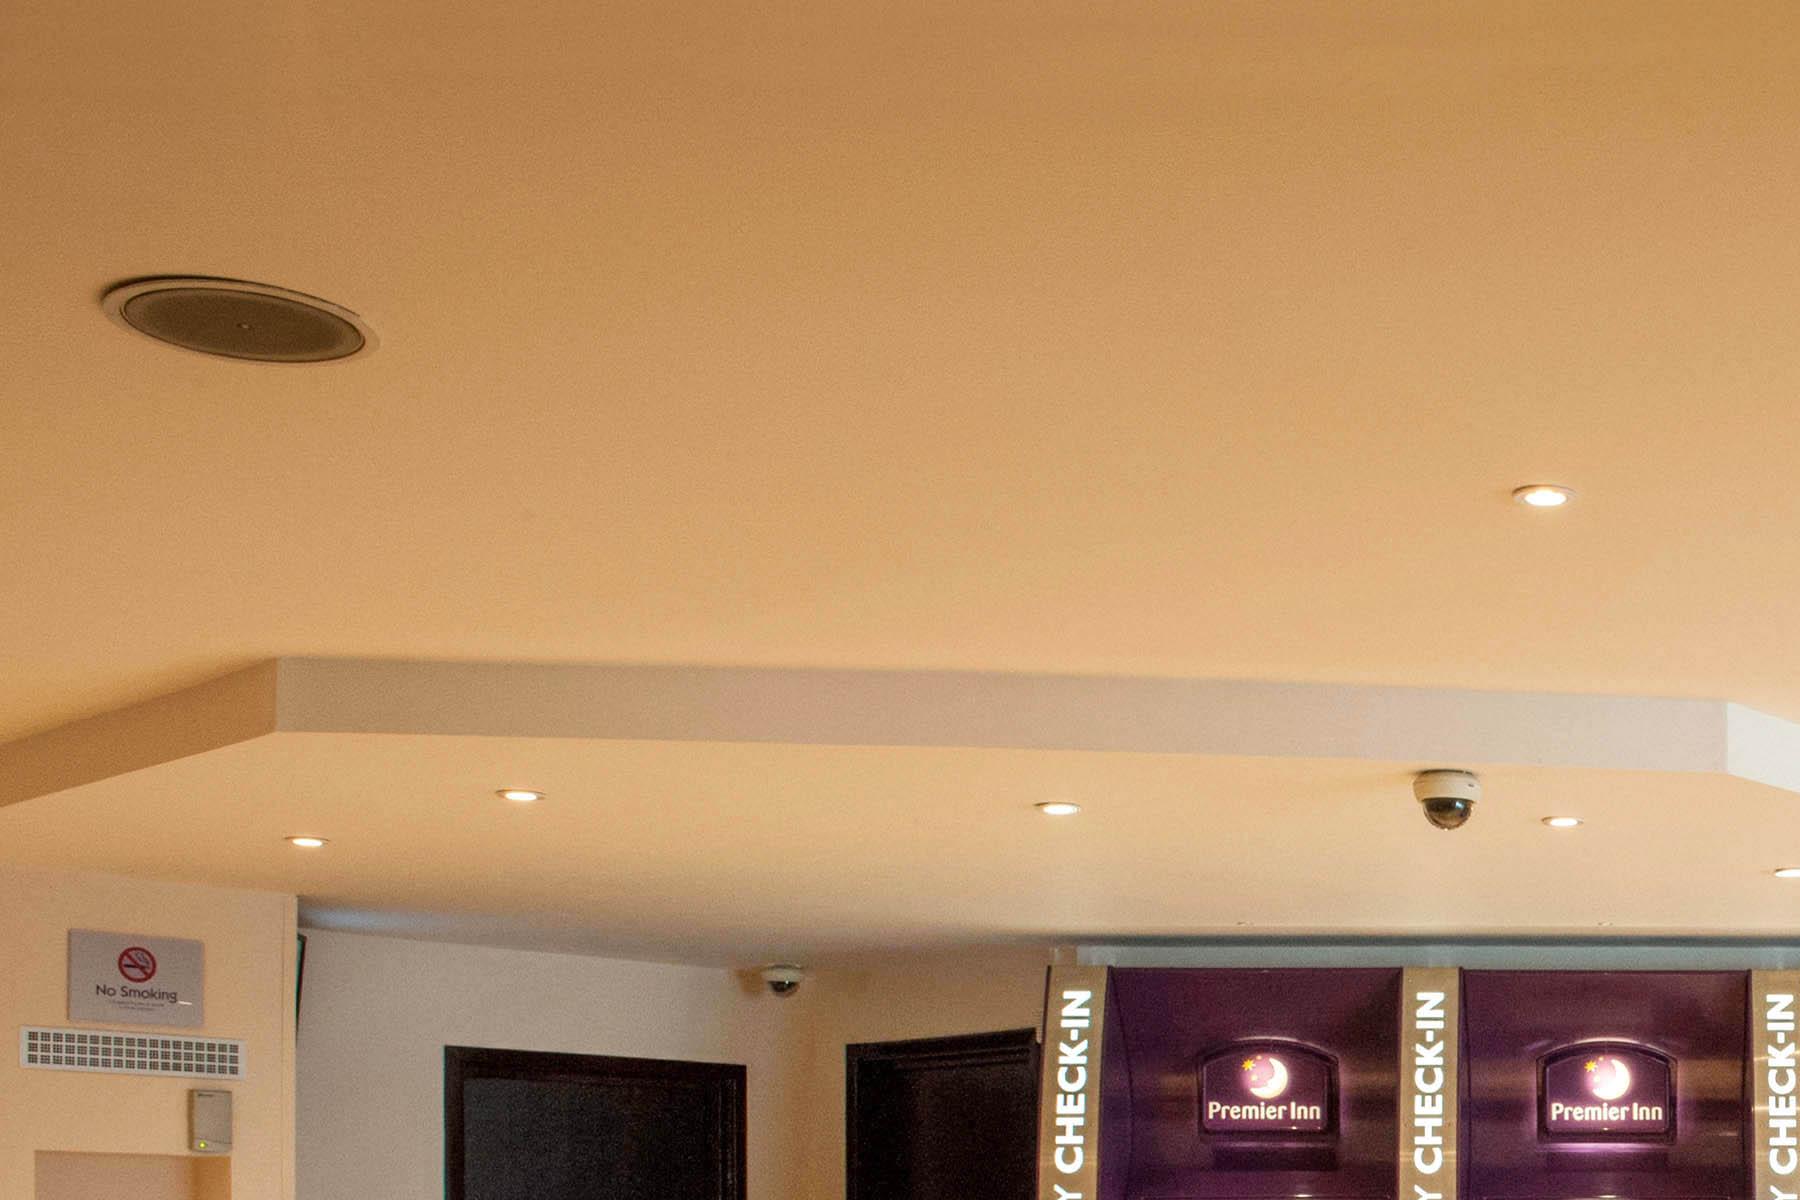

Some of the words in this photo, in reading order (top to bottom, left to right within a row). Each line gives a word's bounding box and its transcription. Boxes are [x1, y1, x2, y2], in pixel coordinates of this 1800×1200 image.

[95, 984, 117, 997] No
[120, 986, 178, 1004] Smoking
[1054, 990, 1091, 1175] CHECK-IN
[1207, 1100, 1288, 1121] Premier
[1290, 1100, 1321, 1121] Inn
[1413, 991, 1445, 1175] CHECK-IN
[1551, 1101, 1630, 1121] Premier
[1632, 1101, 1663, 1121] Inn
[1765, 993, 1799, 1175] CHECK-IN
